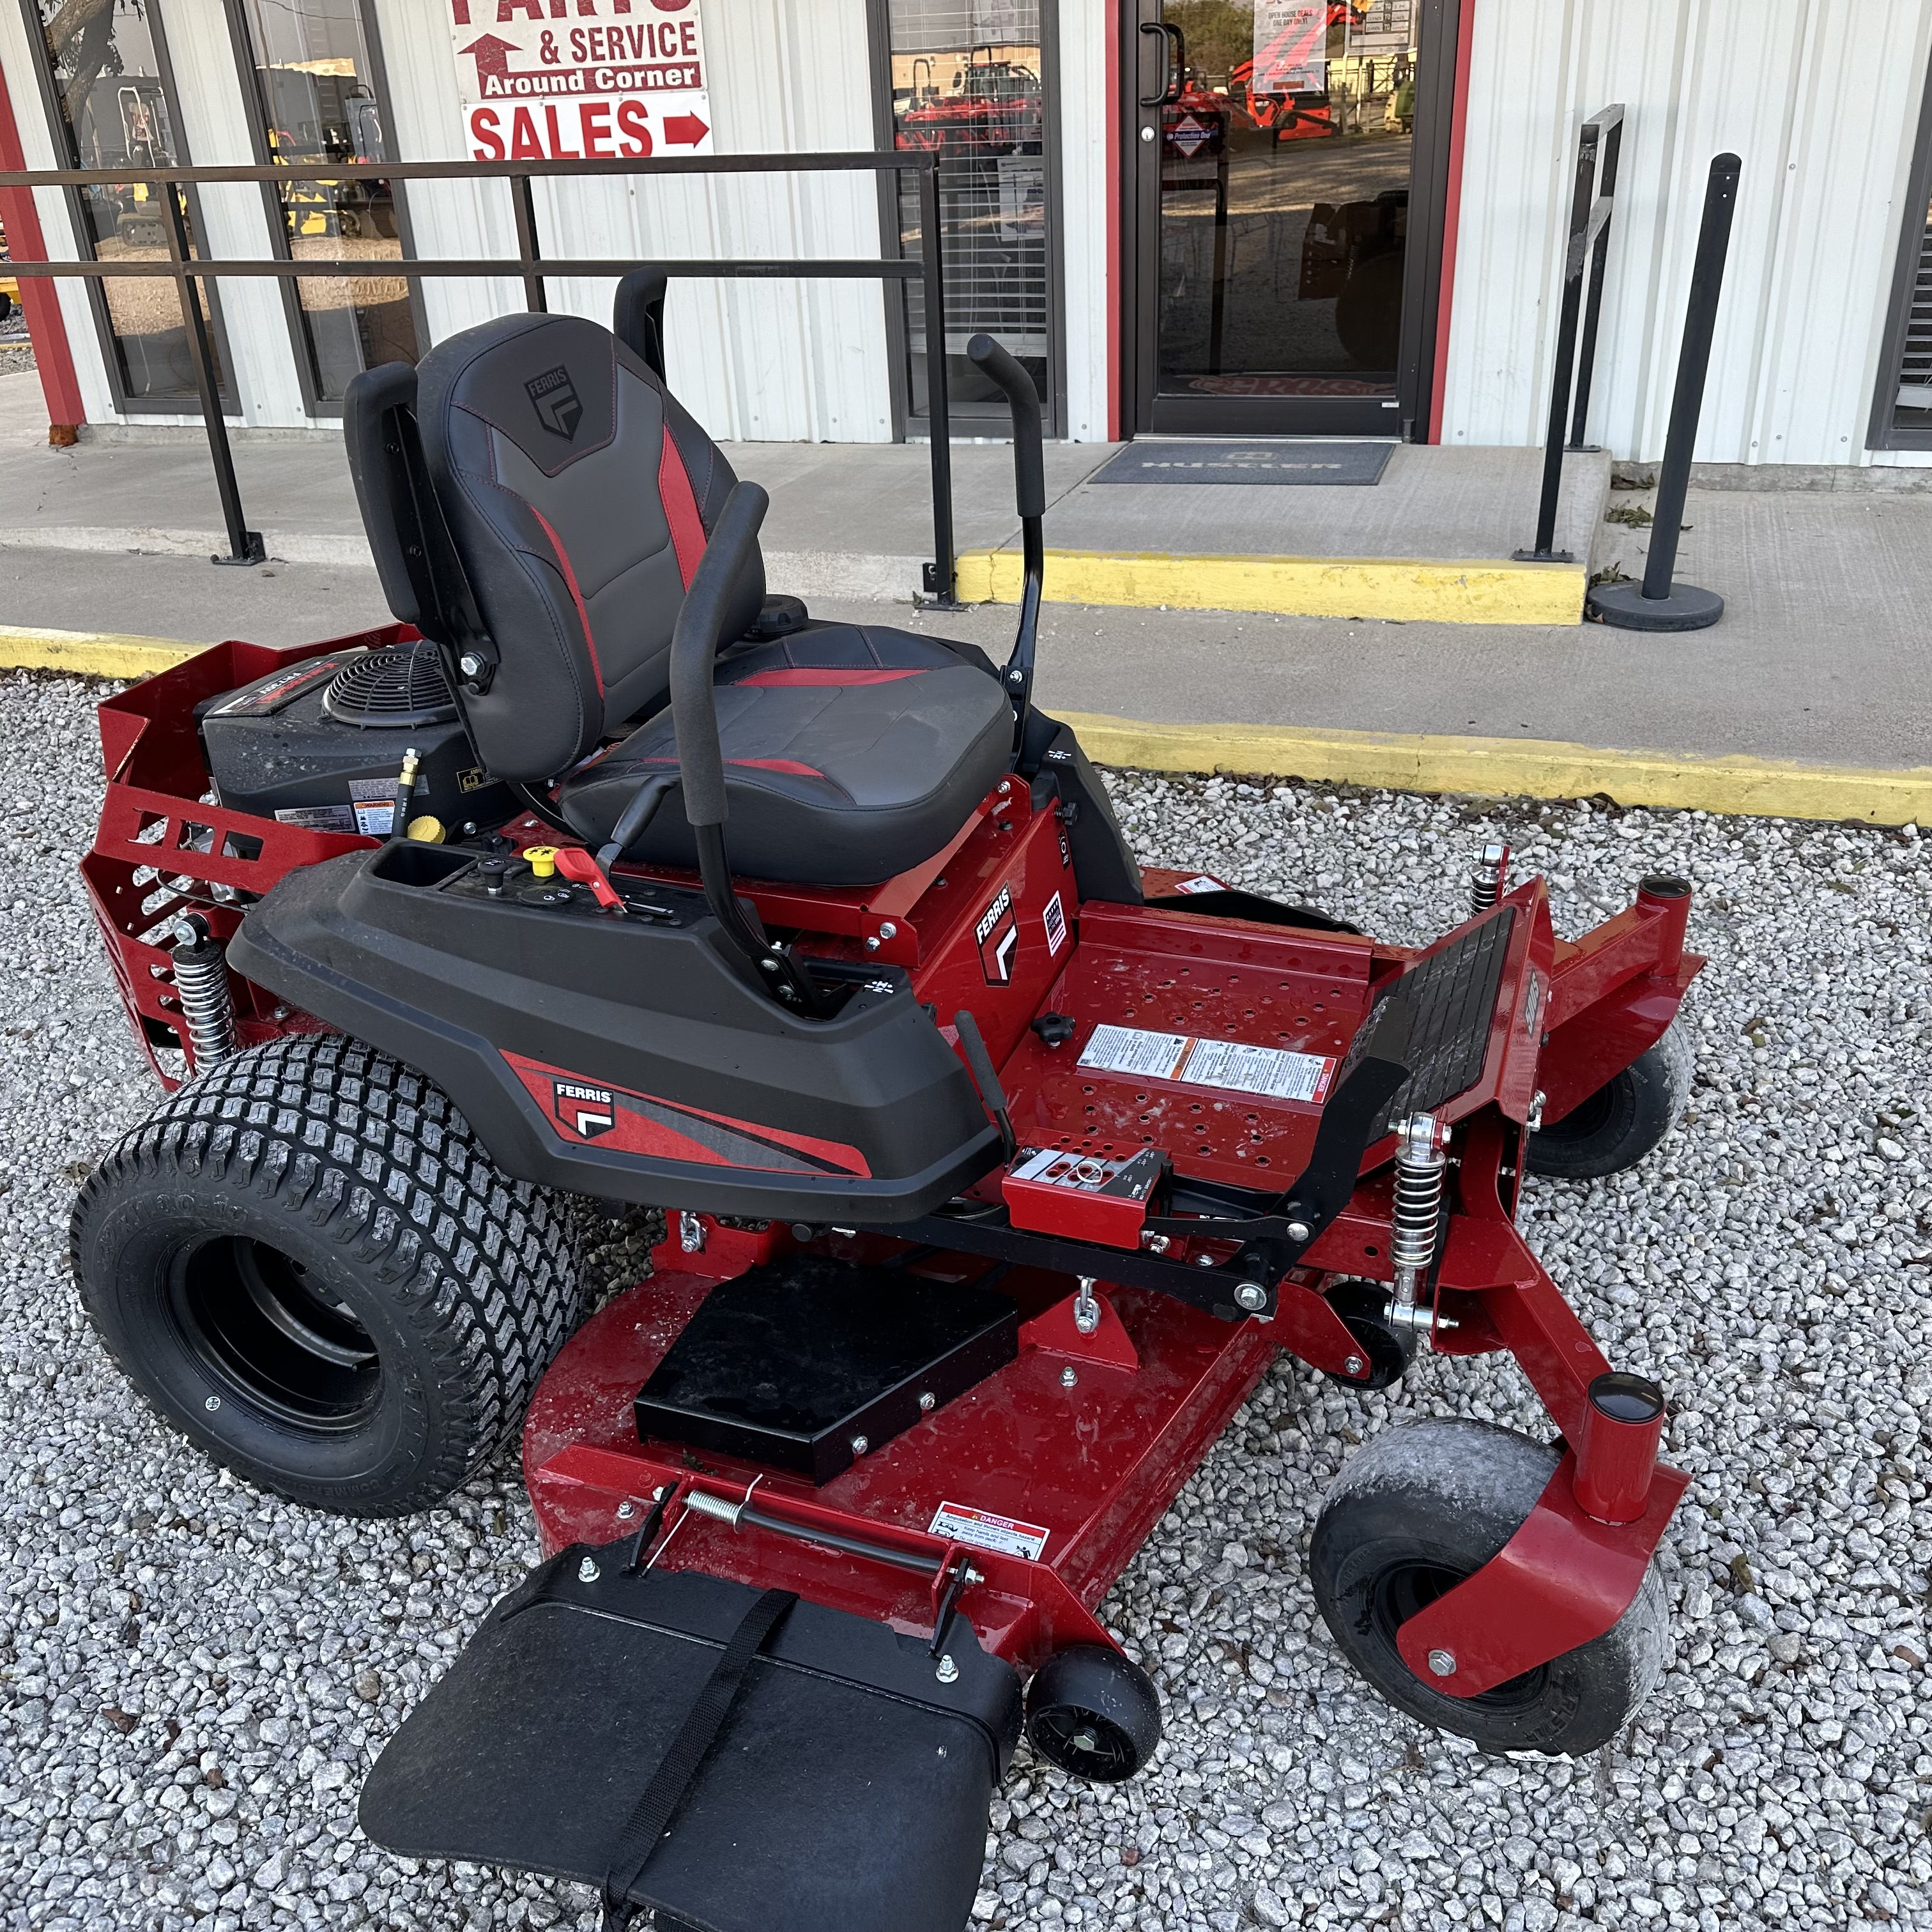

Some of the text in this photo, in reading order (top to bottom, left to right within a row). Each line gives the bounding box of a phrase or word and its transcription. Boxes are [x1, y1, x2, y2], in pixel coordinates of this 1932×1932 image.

[540, 21, 697, 65] & SERVICE
[485, 66, 696, 96] Around Corner
[470, 100, 653, 161] SALES
[528, 369, 567, 397] FERRIS
[976, 888, 1009, 944] FERRIS
[556, 1084, 611, 1103] FERRIS
[1316, 1073, 1329, 1092] DANGER
[946, 1514, 973, 1524] Amputation
[1018, 1533, 1035, 1541] hazard
[980, 1515, 1015, 1529] DANGER
